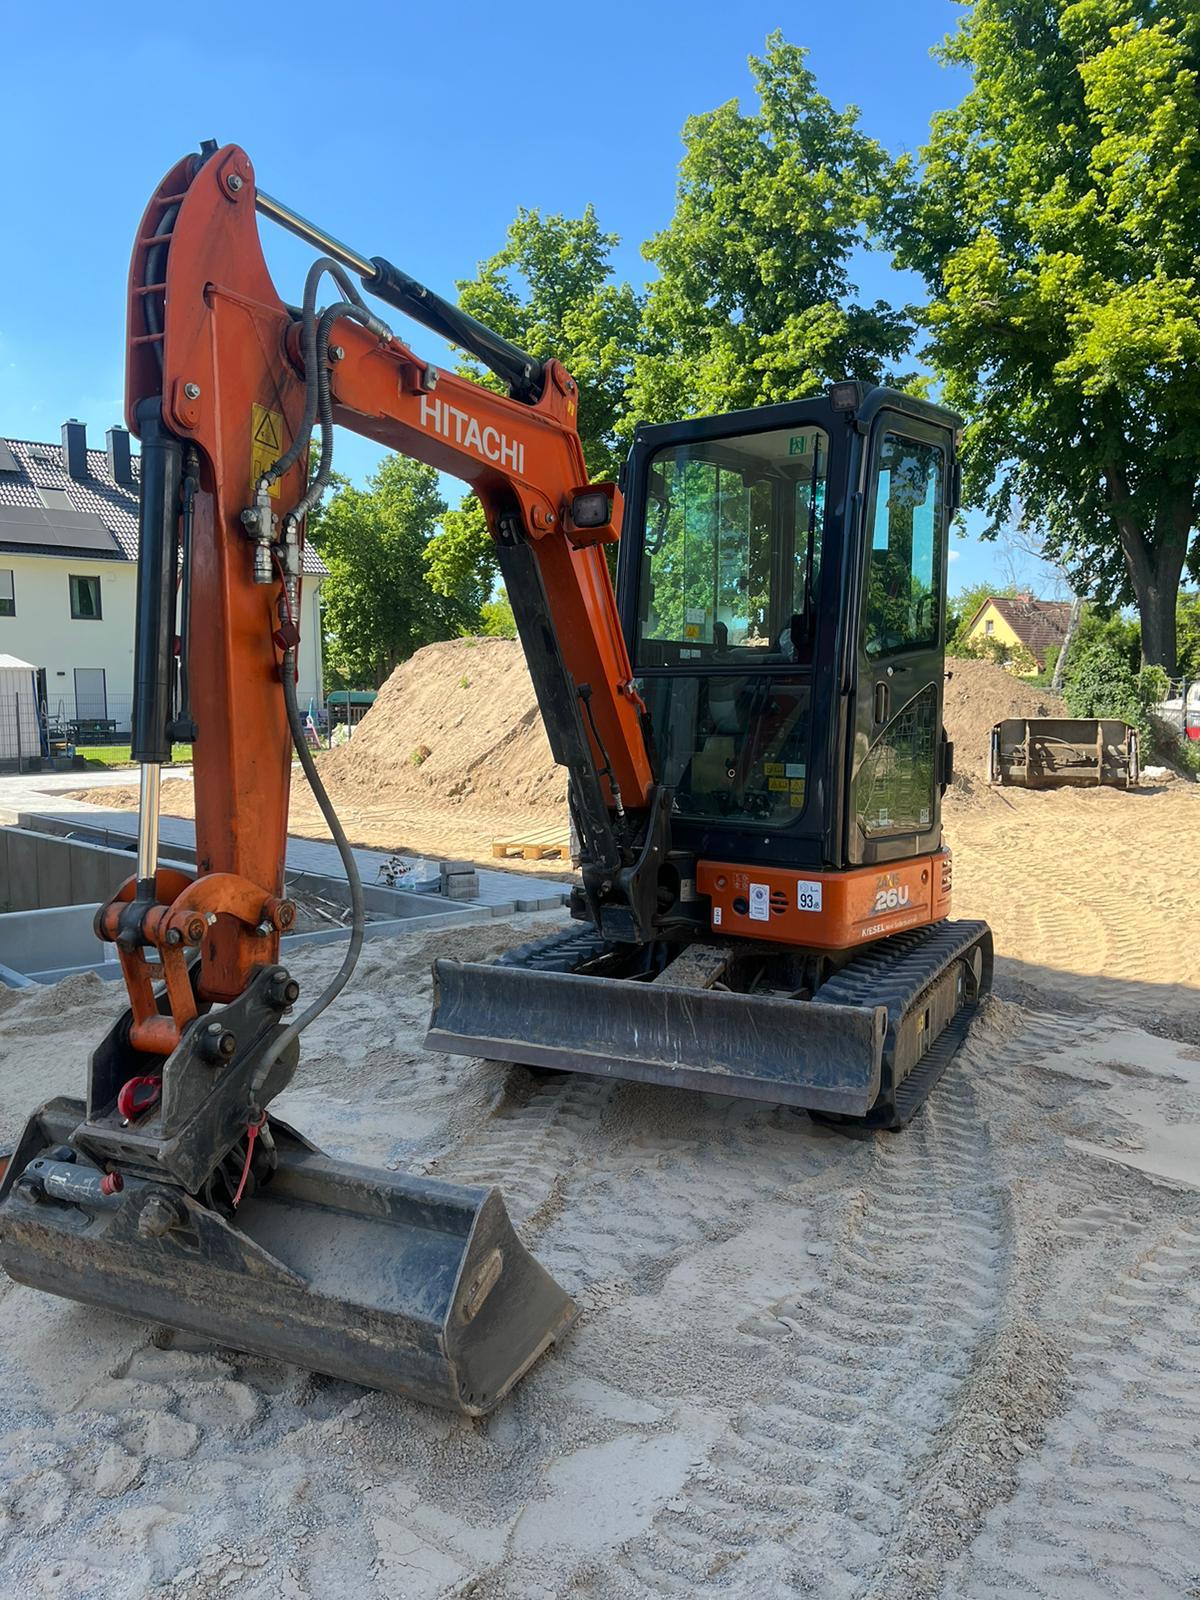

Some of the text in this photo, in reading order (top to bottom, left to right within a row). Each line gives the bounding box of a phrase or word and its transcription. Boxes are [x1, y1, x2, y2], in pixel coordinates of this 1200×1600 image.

[420, 394, 525, 475] HITACHI
[800, 893, 813, 908] 93
[875, 885, 909, 911] 26U
[861, 923, 885, 937] KIESEL
